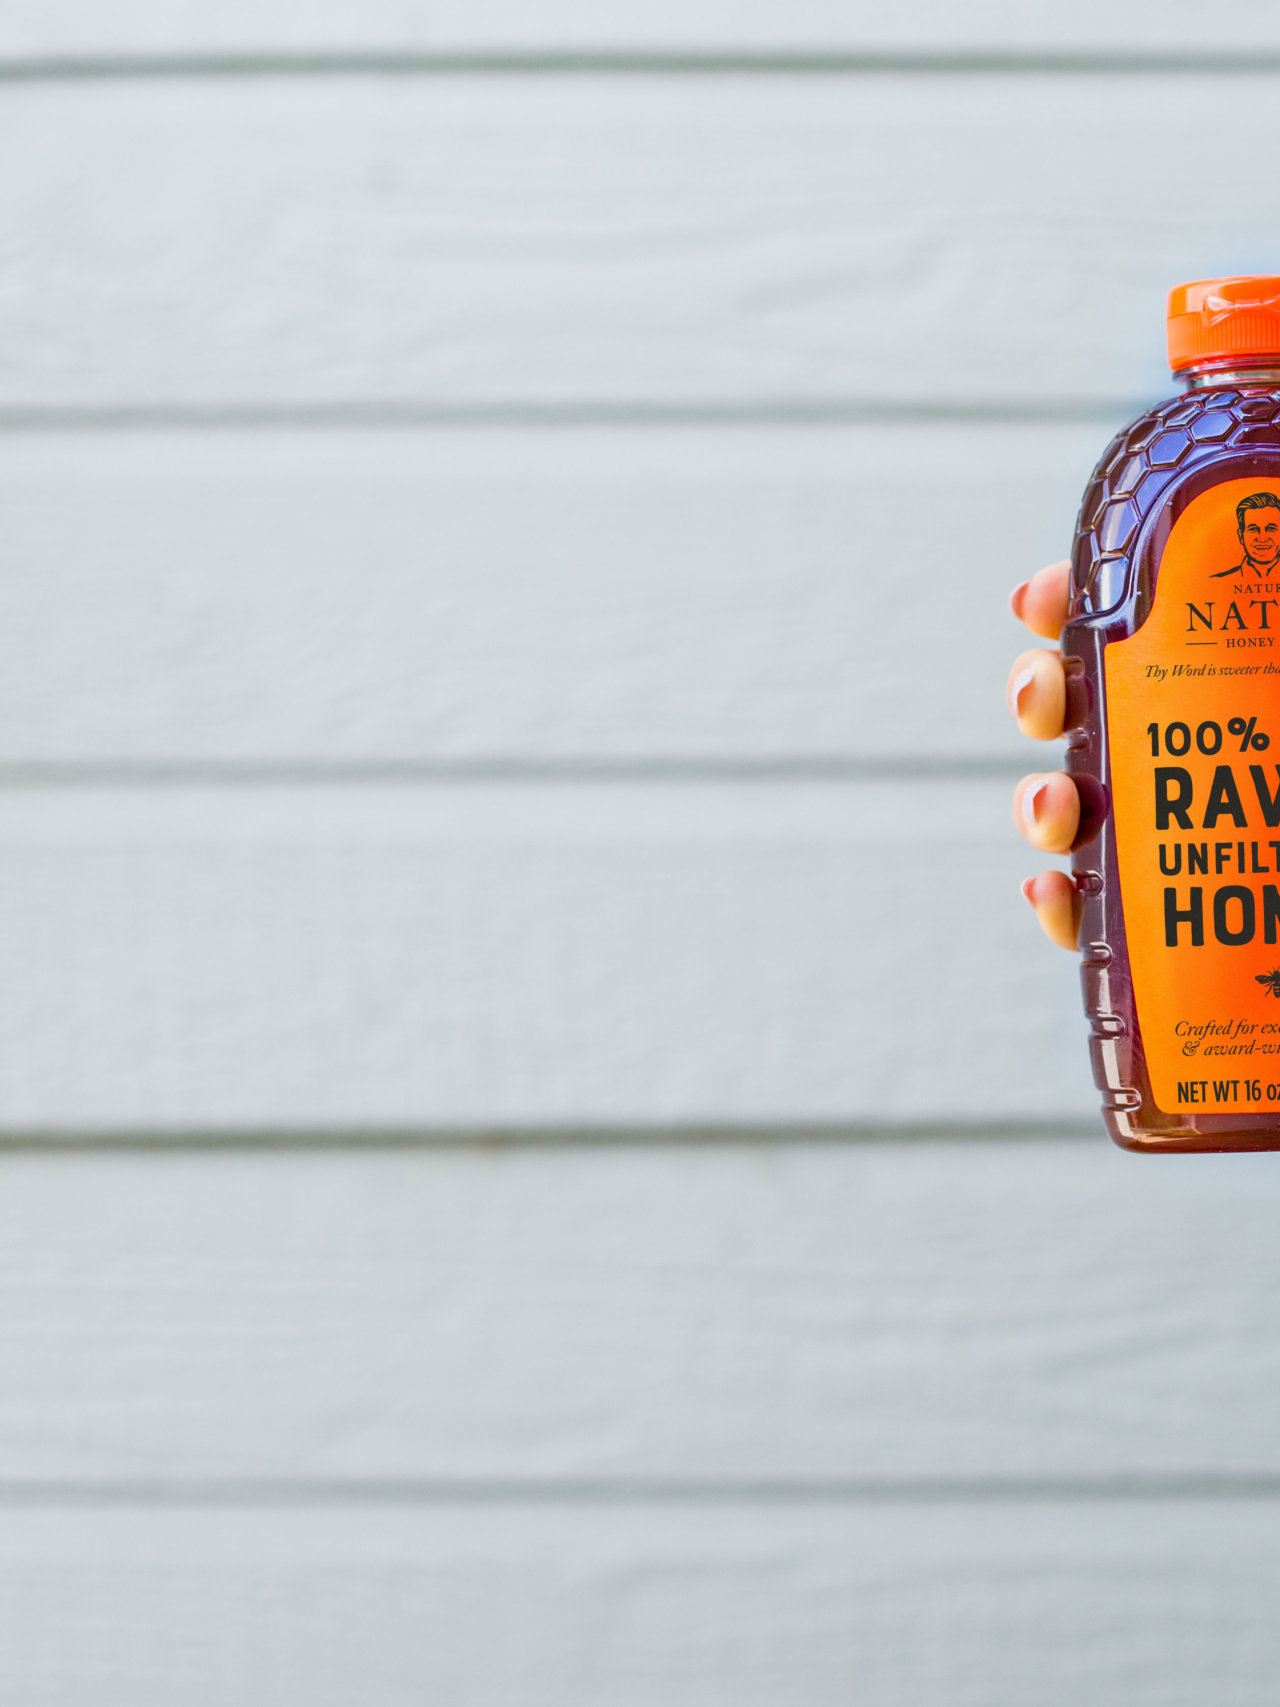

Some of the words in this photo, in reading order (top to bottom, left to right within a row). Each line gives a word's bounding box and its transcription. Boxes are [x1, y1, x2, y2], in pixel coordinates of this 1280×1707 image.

[1226, 637, 1275, 648] HONEY
[1145, 665, 1167, 681] Thy
[1172, 664, 1205, 677] Word
[1208, 664, 1216, 676] is
[1218, 664, 1262, 676] sweeter
[1147, 717, 1270, 756] 100%
[1175, 1020, 1232, 1040] Crafted
[1233, 1020, 1258, 1039] for
[1182, 1040, 1200, 1056] &
[1177, 1081, 1208, 1103] NET
[1213, 1080, 1239, 1102] WT
[1245, 1080, 1261, 1101] 16
